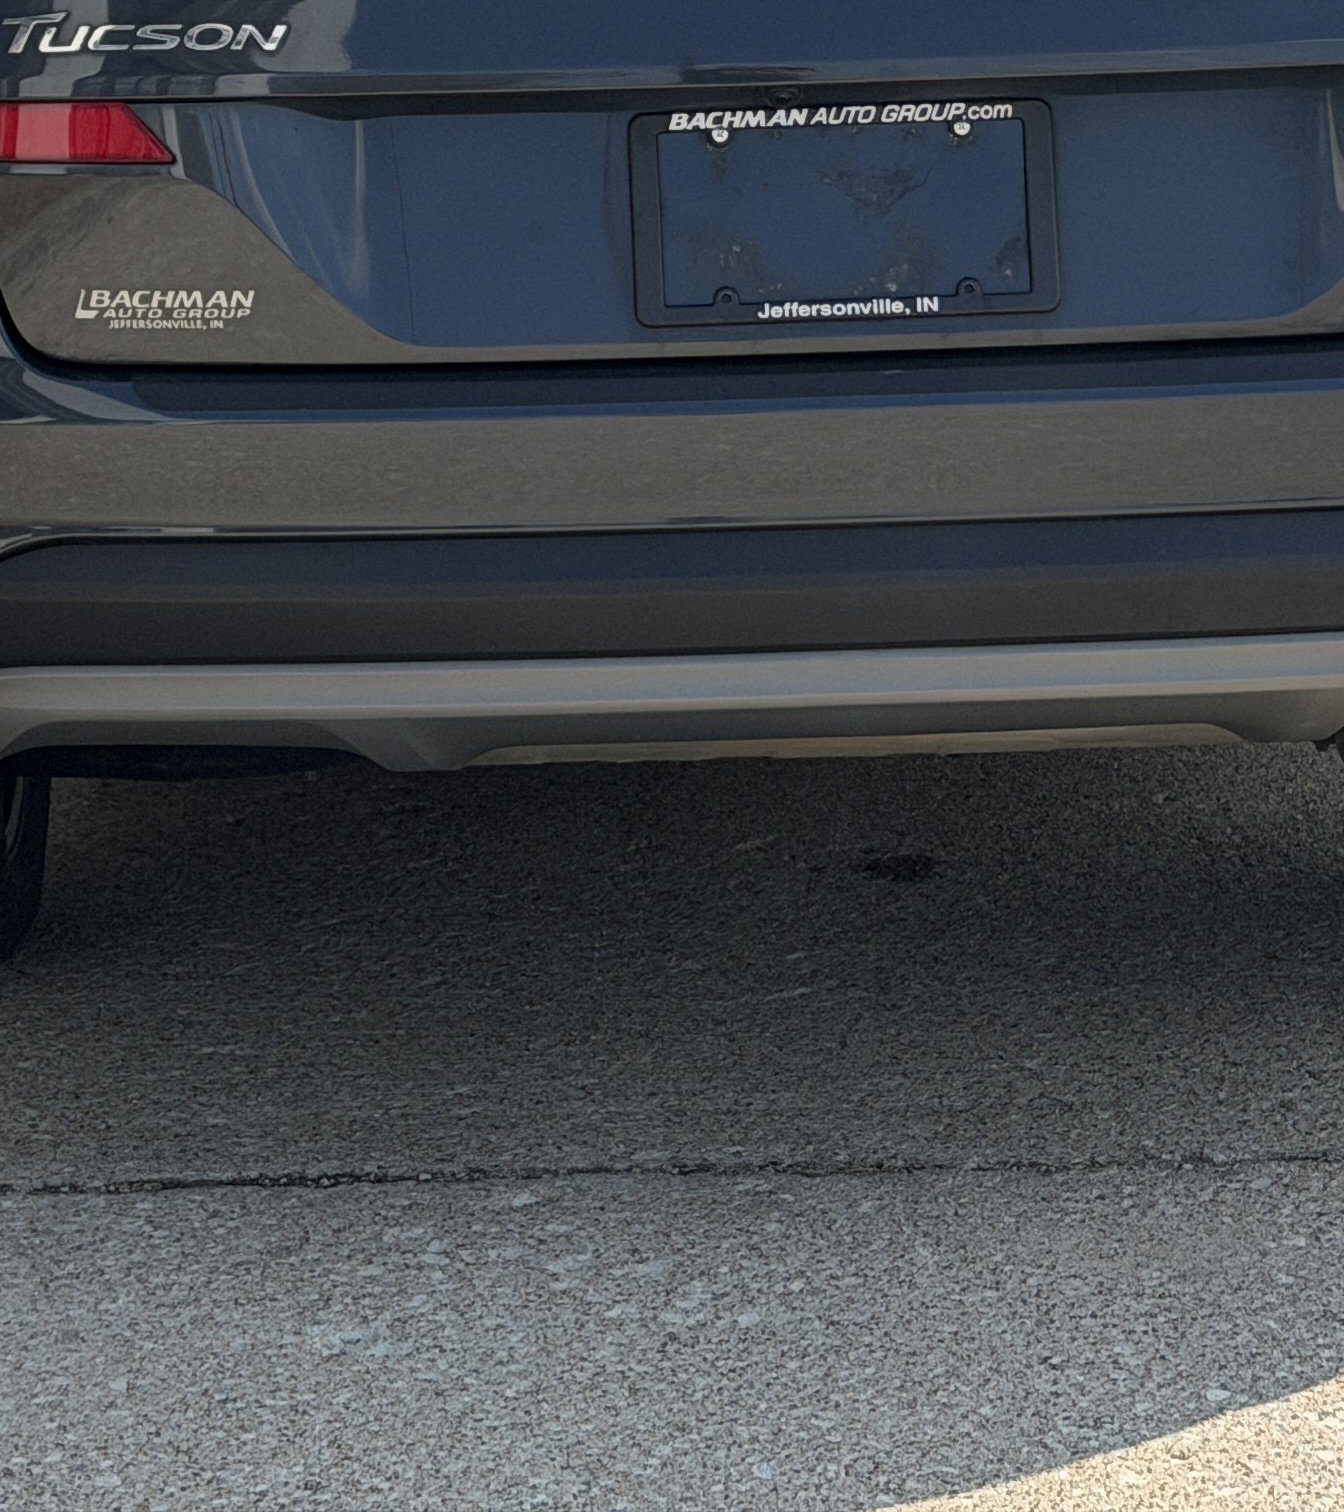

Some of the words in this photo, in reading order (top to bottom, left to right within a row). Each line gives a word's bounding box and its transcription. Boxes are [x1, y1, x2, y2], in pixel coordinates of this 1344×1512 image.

[2, 9, 288, 54] TUCSON
[668, 108, 809, 131] BACHMAN
[810, 105, 876, 126] AUTO
[880, 102, 1013, 124] GROUP.com
[89, 289, 255, 308] BACHMAN
[757, 297, 911, 319] Jeffersonville,
[916, 296, 939, 313] IN
[103, 307, 163, 319] AUTO
[172, 307, 252, 319] GROUP
[109, 319, 207, 330] JEFFERSONVILLE,
[209, 319, 224, 329] IN
